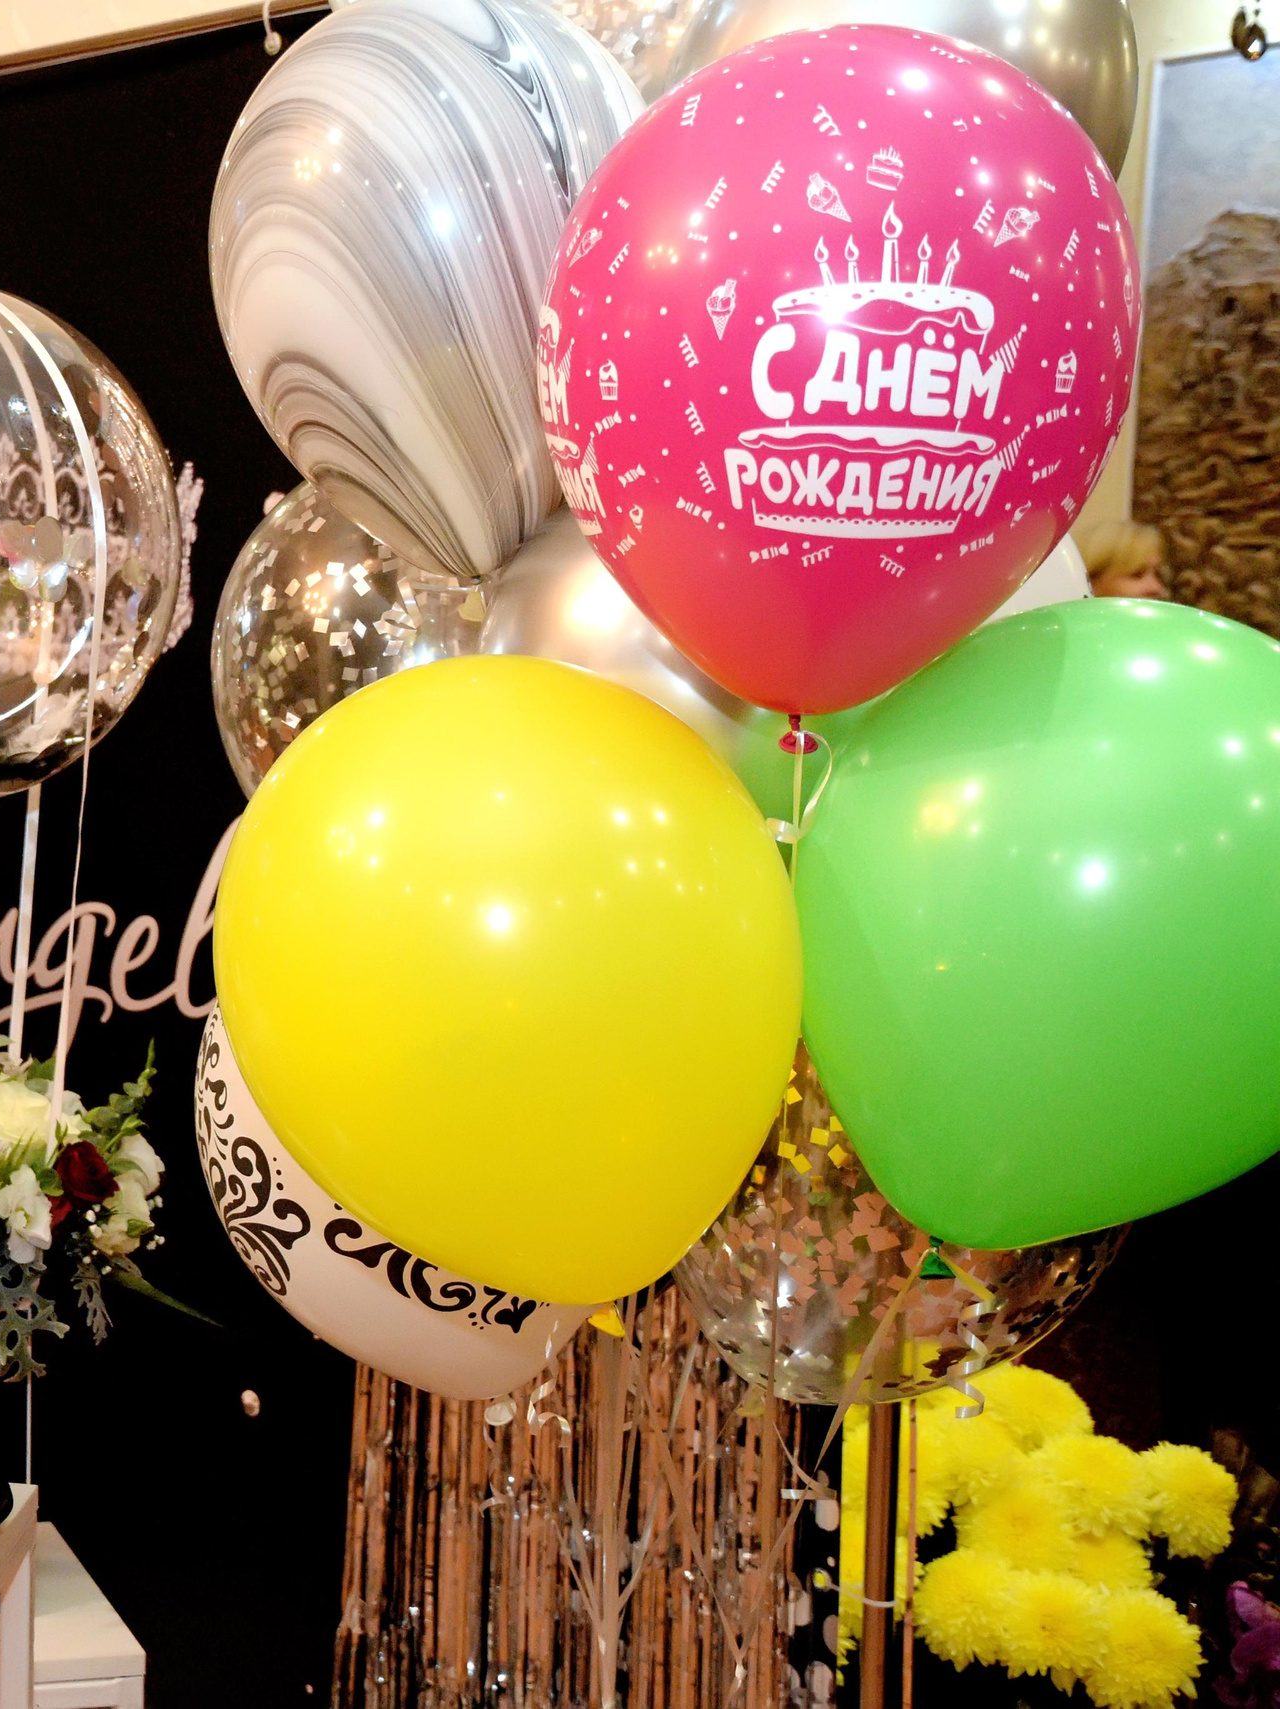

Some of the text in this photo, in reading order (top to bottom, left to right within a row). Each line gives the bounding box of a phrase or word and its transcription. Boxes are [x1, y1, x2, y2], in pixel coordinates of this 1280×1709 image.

[751, 323, 1004, 420] С ДНЁМ
[724, 448, 1003, 517] РОЖДЕНИЯ
